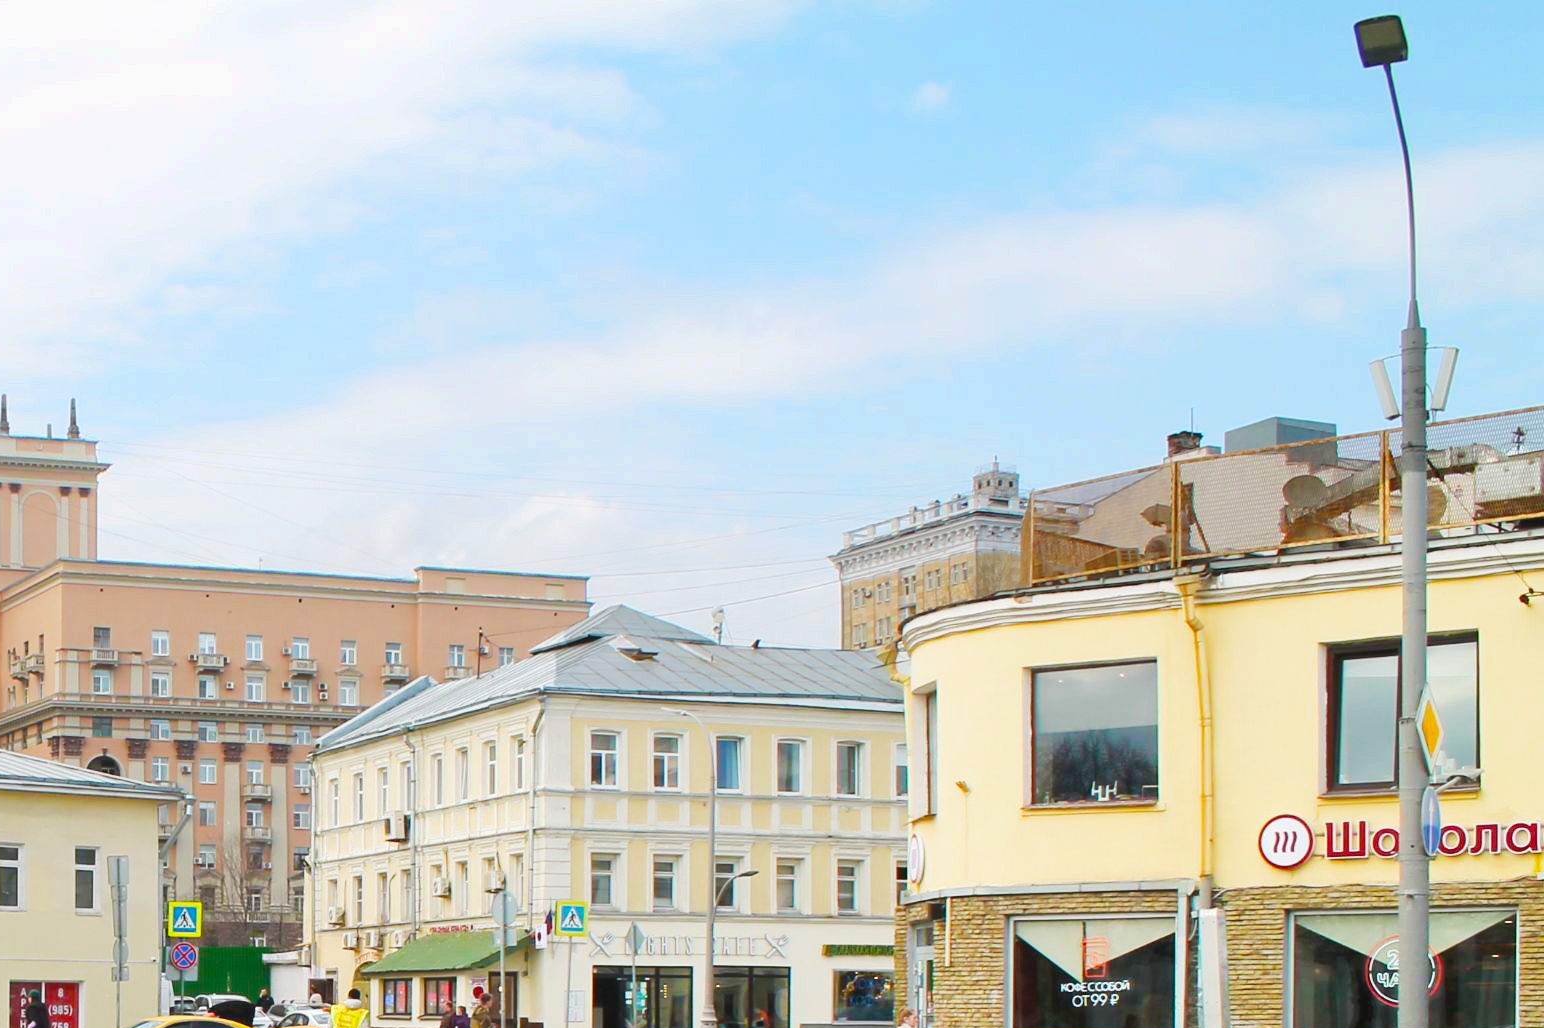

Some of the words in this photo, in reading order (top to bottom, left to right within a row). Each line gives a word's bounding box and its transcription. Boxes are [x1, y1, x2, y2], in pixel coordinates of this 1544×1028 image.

[1324, 819, 1541, 859] Шоола
[711, 936, 756, 957] AFE
[57, 987, 64, 998] 8
[1060, 982, 1087, 992] КОФЕ
[1072, 995, 1090, 1007] ОТ
[1090, 993, 1108, 1006] 99
[48, 1004, 73, 1017] (985)
